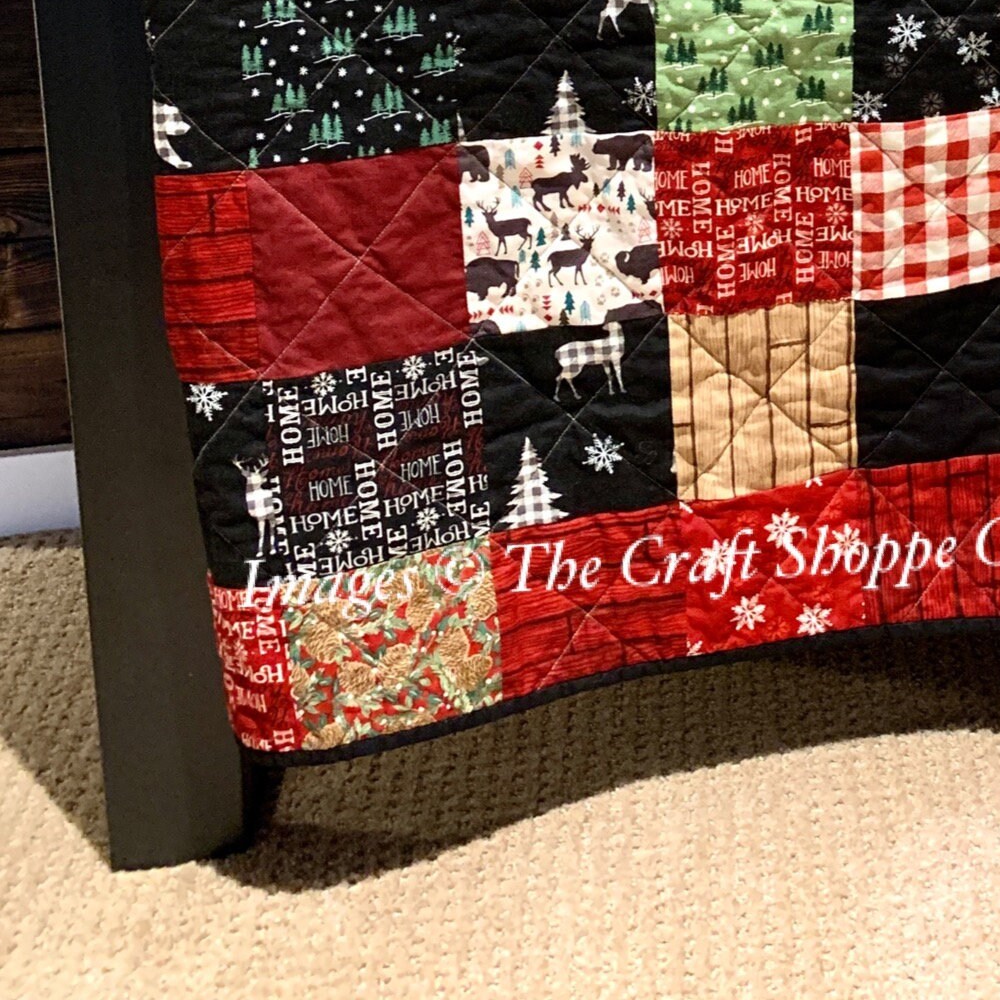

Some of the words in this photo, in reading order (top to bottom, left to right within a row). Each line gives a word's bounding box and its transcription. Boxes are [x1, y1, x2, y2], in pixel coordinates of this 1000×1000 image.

[692, 161, 713, 234] HOME
[734, 163, 771, 189] HOME
[773, 154, 792, 223] HOME
[716, 225, 736, 299] HOME
[739, 257, 776, 283] HOME
[795, 212, 815, 285] HOME
[370, 370, 398, 451] HOME
[400, 403, 440, 432] HOME
[457, 350, 484, 428] HOME
[277, 387, 304, 466] HOME
[306, 424, 349, 449] HOME
[309, 475, 353, 502] HOME
[354, 459, 383, 541] HOME
[401, 454, 442, 482] HOME
[442, 439, 467, 517] HOME
